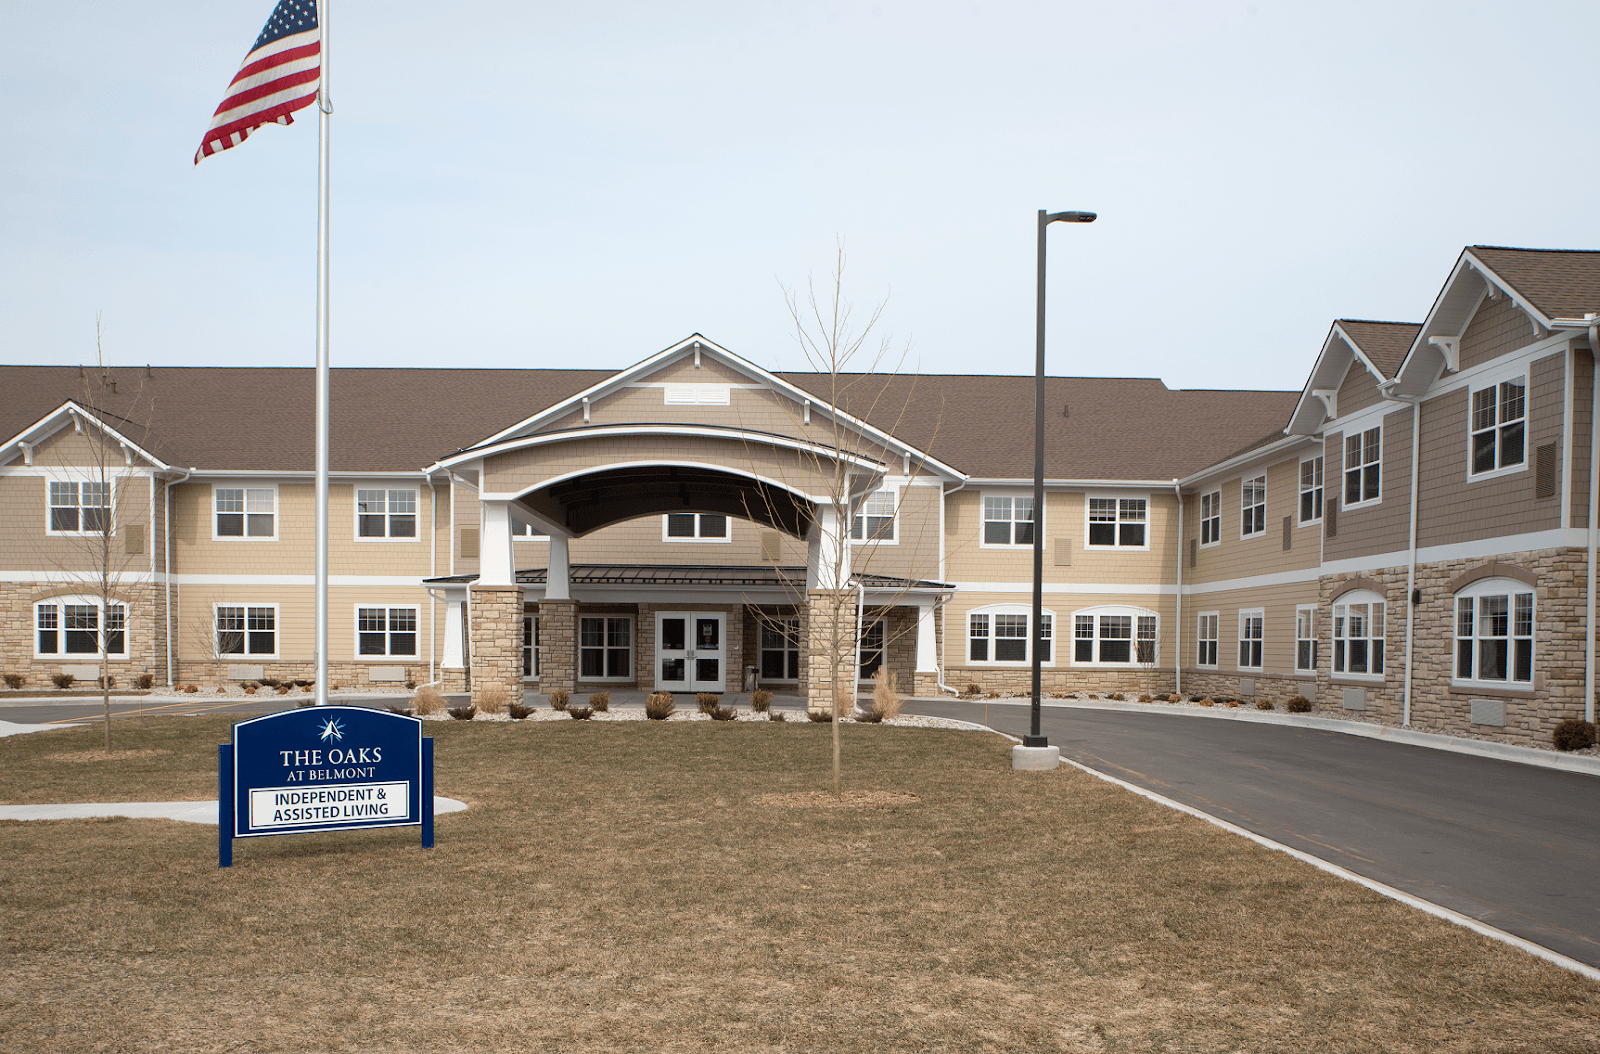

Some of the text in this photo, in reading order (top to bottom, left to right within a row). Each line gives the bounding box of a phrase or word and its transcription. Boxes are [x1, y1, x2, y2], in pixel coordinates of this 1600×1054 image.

[280, 747, 382, 767] THE OAKS
[287, 766, 376, 782] AT BELMONT
[275, 787, 387, 806] INDEPENDENT &
[273, 803, 389, 822] ASSISTED LIVING
